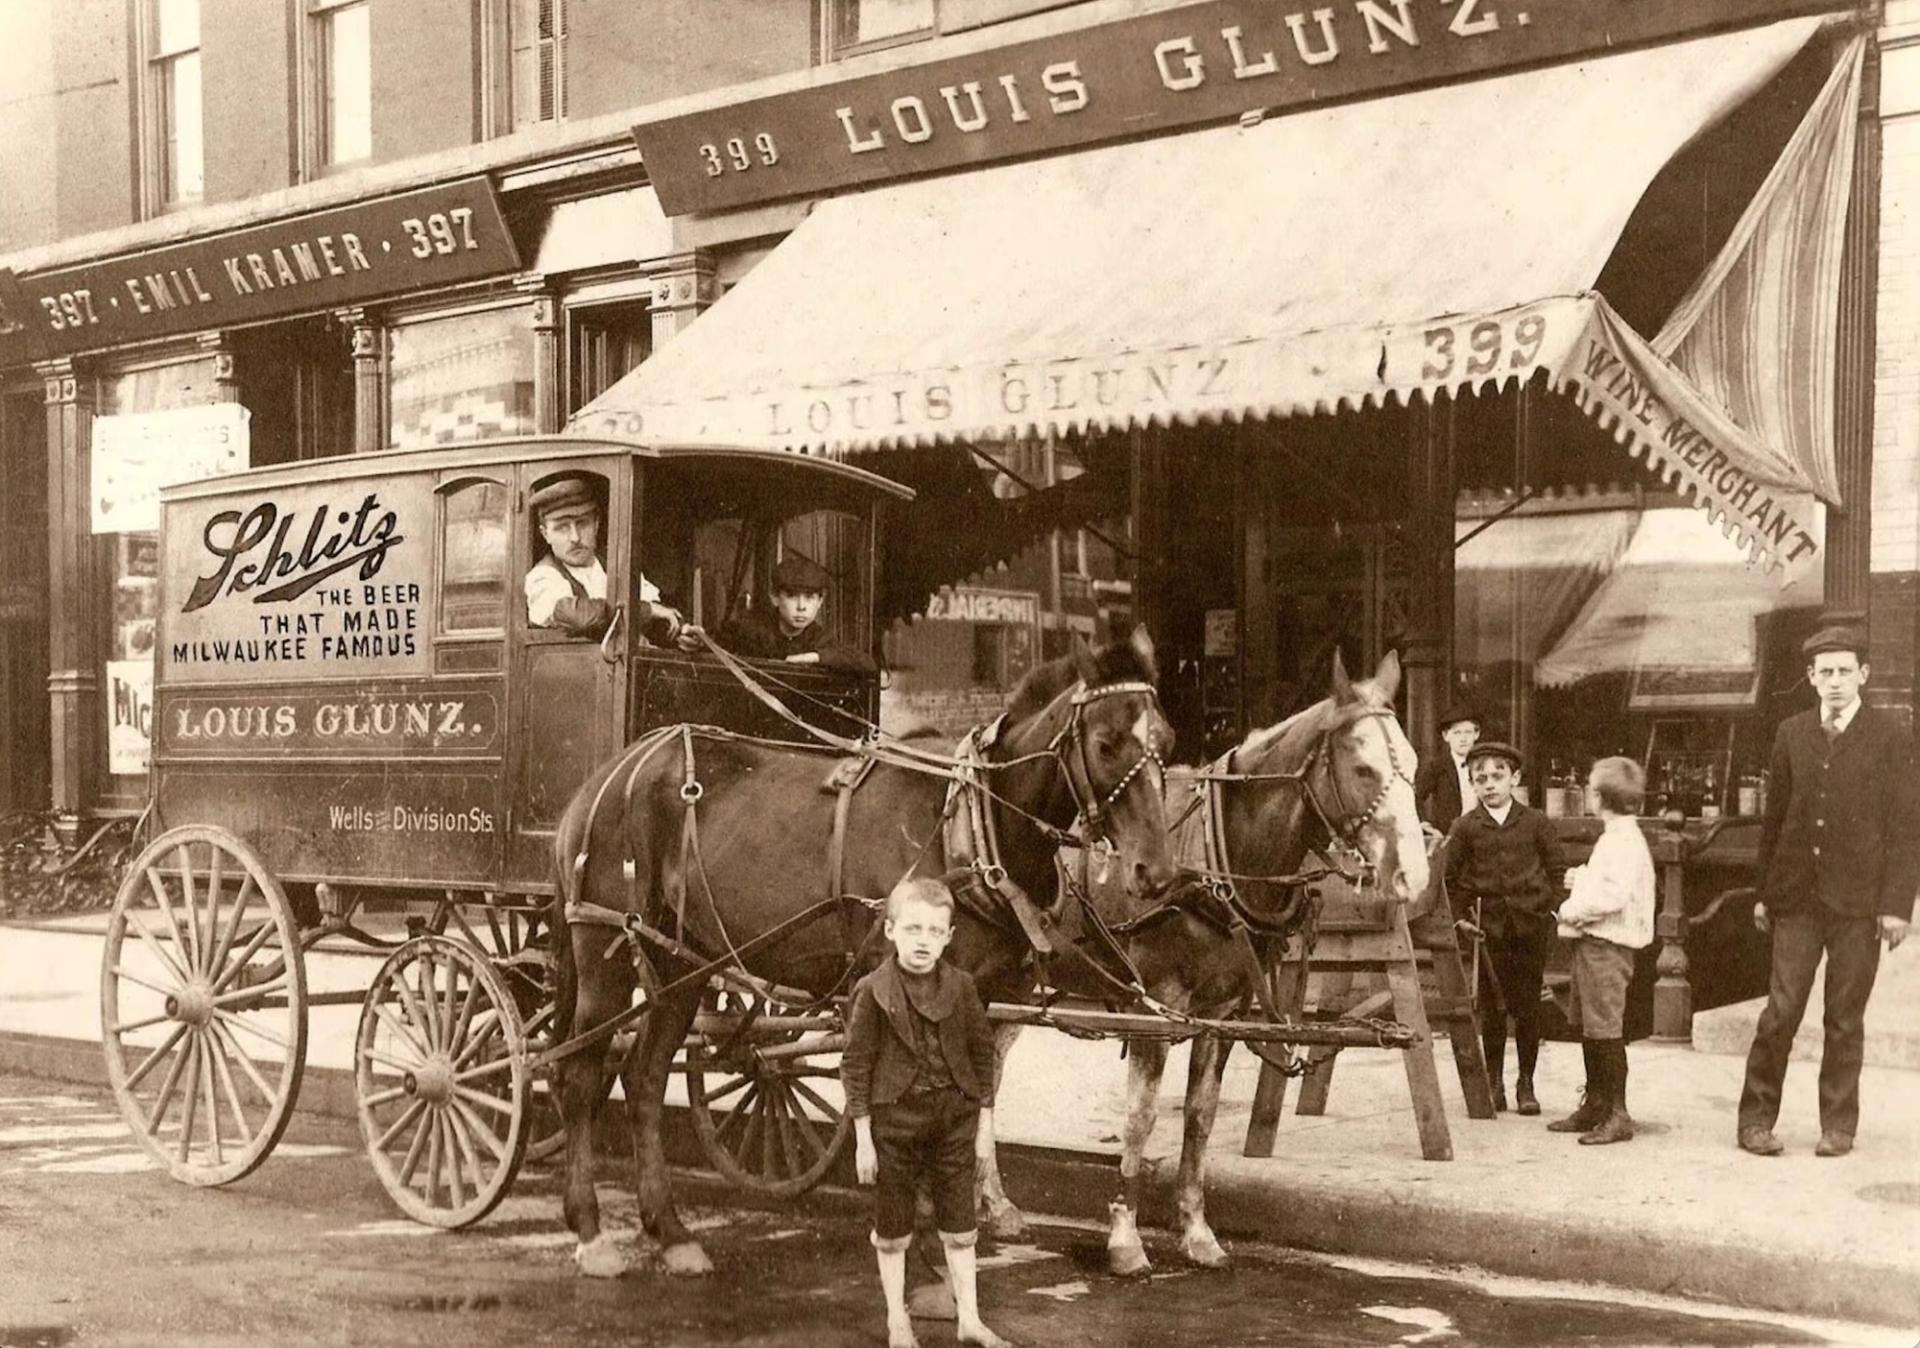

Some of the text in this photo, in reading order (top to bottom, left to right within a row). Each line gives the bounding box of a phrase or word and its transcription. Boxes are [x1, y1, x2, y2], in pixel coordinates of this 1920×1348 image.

[699, 132, 780, 178] 399
[836, 60, 1090, 155] LOUIS
[40, 288, 99, 332] 397
[126, 267, 212, 315] EMIL
[223, 232, 371, 296] KRAMER
[401, 207, 481, 261] 397
[768, 314, 1548, 437] LOUIS GLUNZ 399
[1584, 340, 1819, 564] WINE MERCHANT
[181, 493, 404, 613] Schlitz
[260, 607, 418, 636] THAT MADE
[316, 583, 421, 607] THE BEER
[173, 633, 417, 663] MILWAUKEE FAMOUS
[175, 701, 483, 738] LOUIS GLUNZ.
[329, 805, 374, 831] Wells
[393, 805, 469, 832] Division
